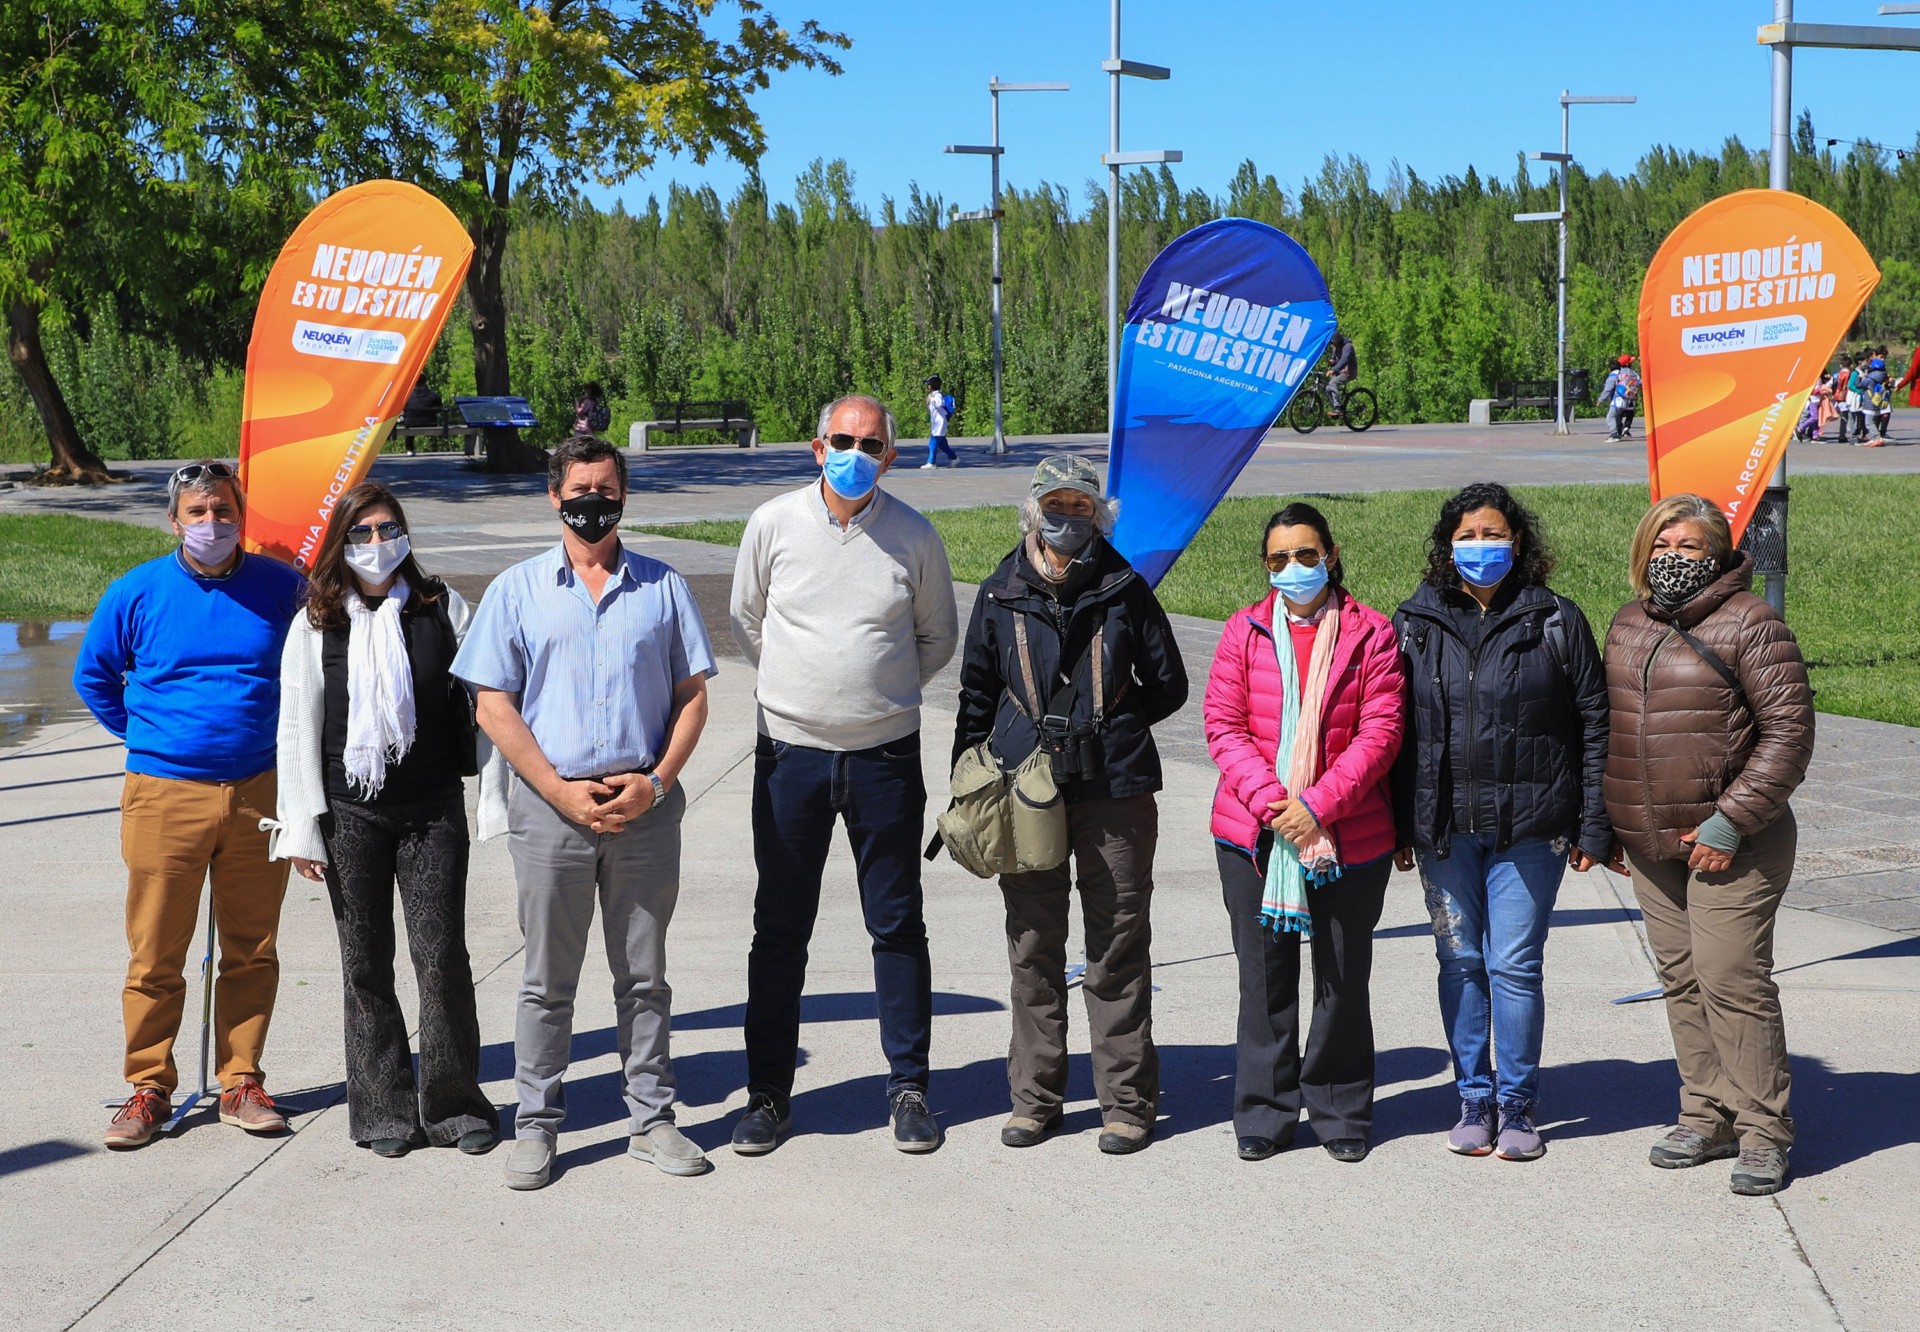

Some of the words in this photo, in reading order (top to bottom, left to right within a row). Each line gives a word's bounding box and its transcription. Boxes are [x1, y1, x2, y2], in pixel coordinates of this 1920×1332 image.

[311, 243, 443, 289] NEUQUÉN
[1682, 234, 1823, 288] NEUQUÉN
[291, 280, 318, 308] ES
[316, 285, 343, 311] TU
[341, 285, 440, 321] DESTINO
[1670, 293, 1695, 318] ES
[1697, 290, 1722, 314] TU
[1726, 273, 1836, 312] DESTINO
[1160, 281, 1312, 353] NEUQUÉN
[1763, 326, 1801, 336] PODEMOS
[1764, 322, 1793, 331] JUNTOS
[299, 341, 350, 353] PROVINCIA
[302, 329, 353, 345] NEUQUÉN
[366, 343, 399, 352] PODEMOS
[368, 337, 394, 346] JUNTOS
[1690, 340, 1746, 351] PROVINCIA
[1691, 328, 1746, 344] NEUQUÉN
[1135, 318, 1167, 348] ES
[1165, 326, 1198, 356] TU
[1194, 331, 1308, 387] DESTINO
[1167, 362, 1213, 381] PATAGONIA
[1213, 375, 1259, 394] ARGENTINA
[1735, 391, 1790, 496] ARGENTINA
[293, 525, 323, 570] ONIA
[318, 415, 379, 522] ARGENTINA
